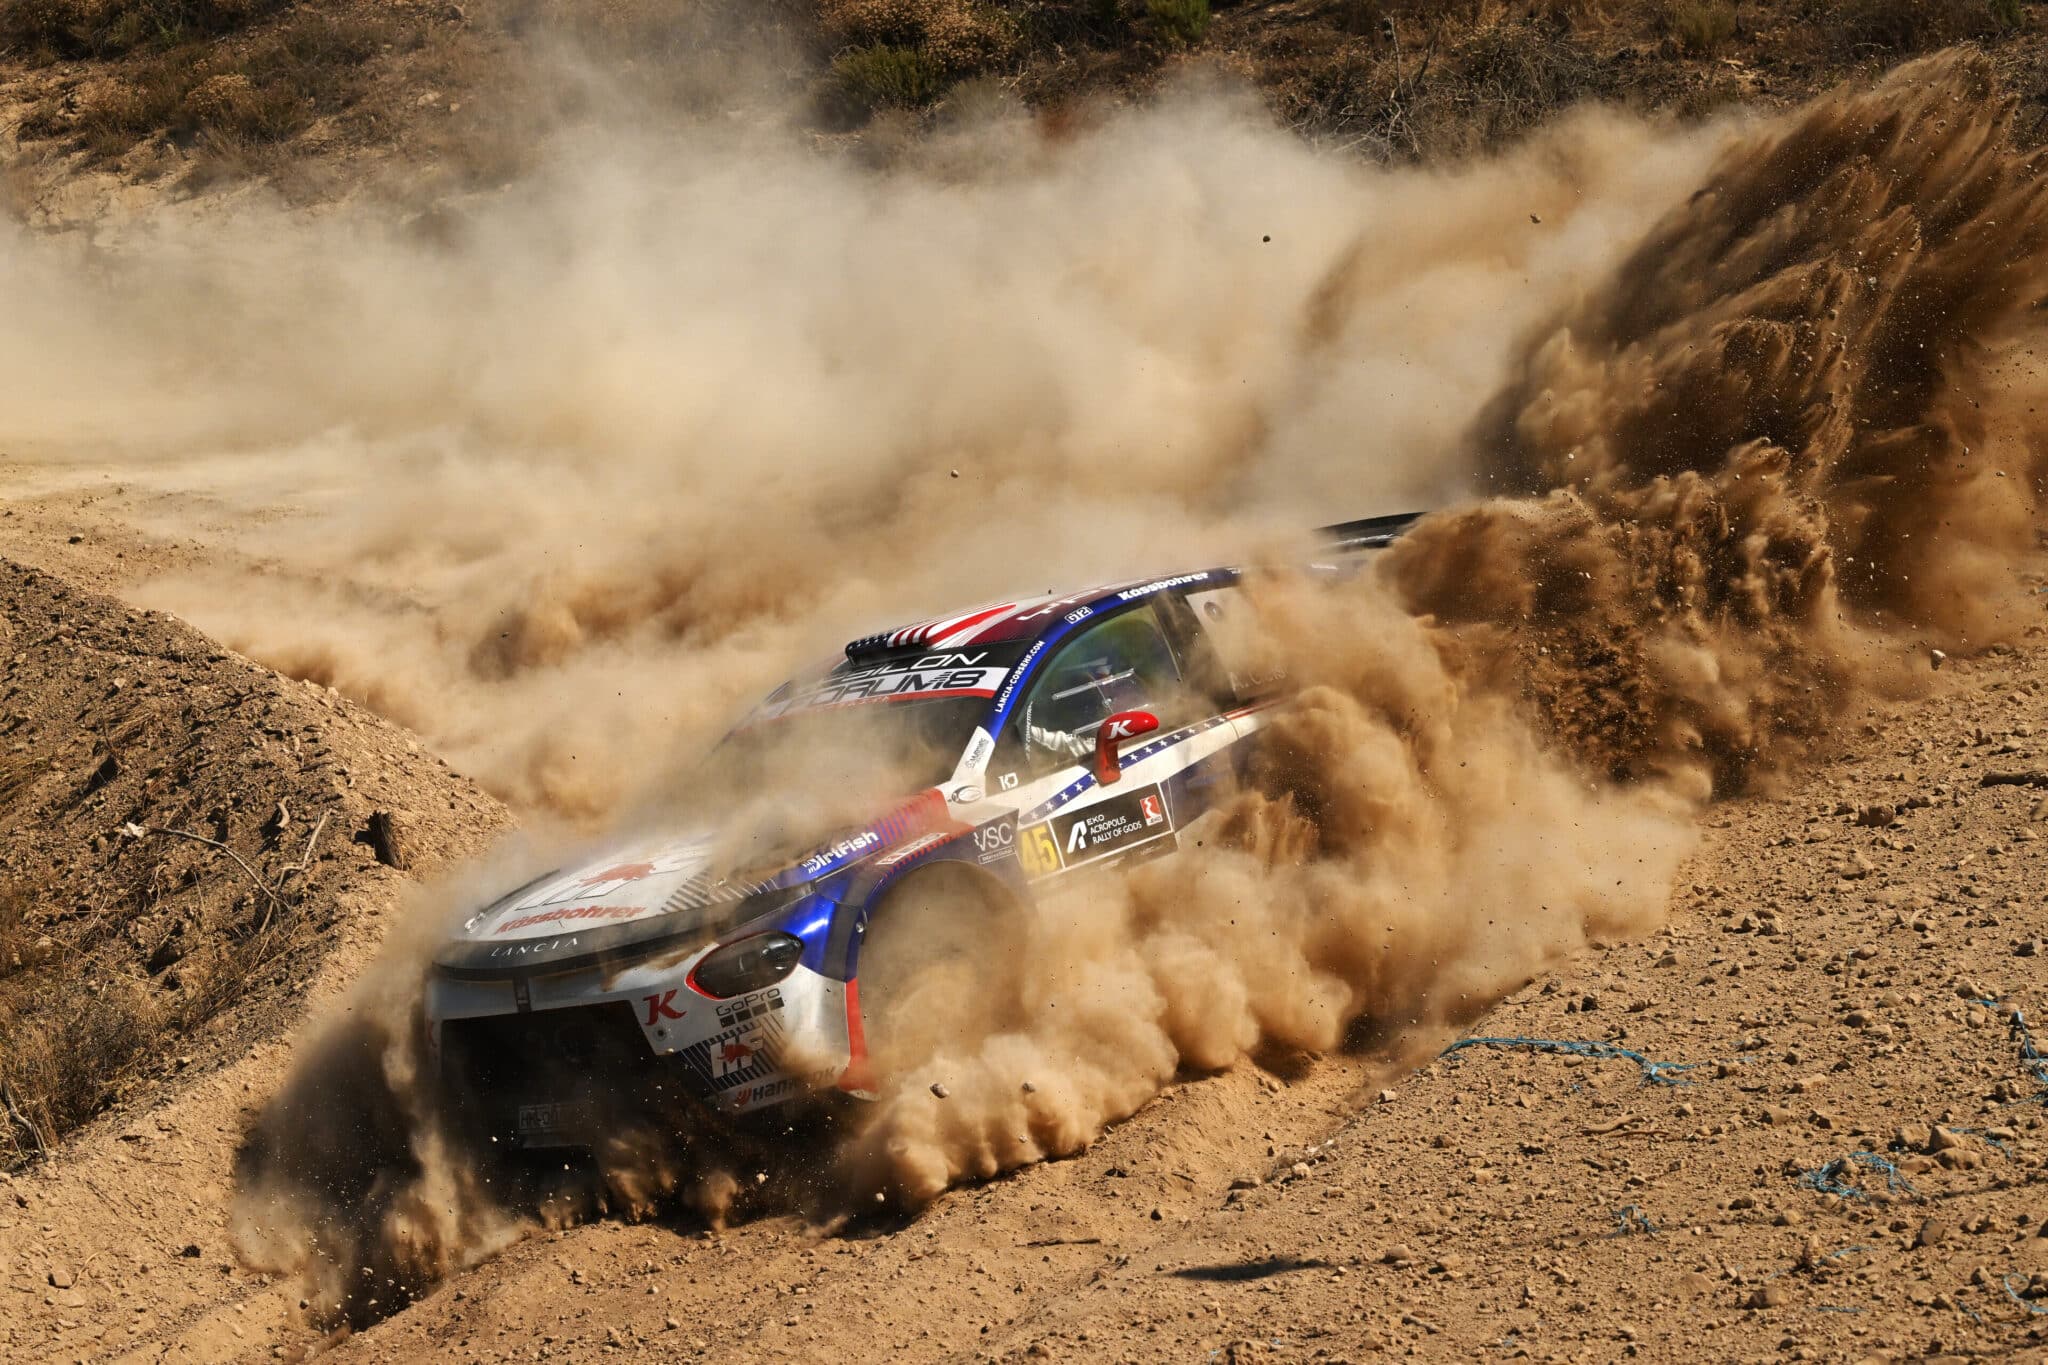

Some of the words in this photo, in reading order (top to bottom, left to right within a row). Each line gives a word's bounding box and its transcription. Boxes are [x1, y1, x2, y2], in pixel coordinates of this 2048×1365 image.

[1065, 606, 1093, 624] GT2i
[1107, 719, 1135, 740] K
[1086, 814, 1104, 826] EKO
[1090, 816, 1127, 835] ACROPOLIS
[974, 822, 1013, 851] VSC
[1092, 832, 1112, 845] RALLY
[1112, 828, 1122, 837] OF
[1122, 820, 1142, 834] GODS
[1021, 825, 1058, 871] 45
[491, 937, 578, 957] LANCIA
[643, 989, 687, 1026] K
[716, 987, 780, 1017] GoPro
